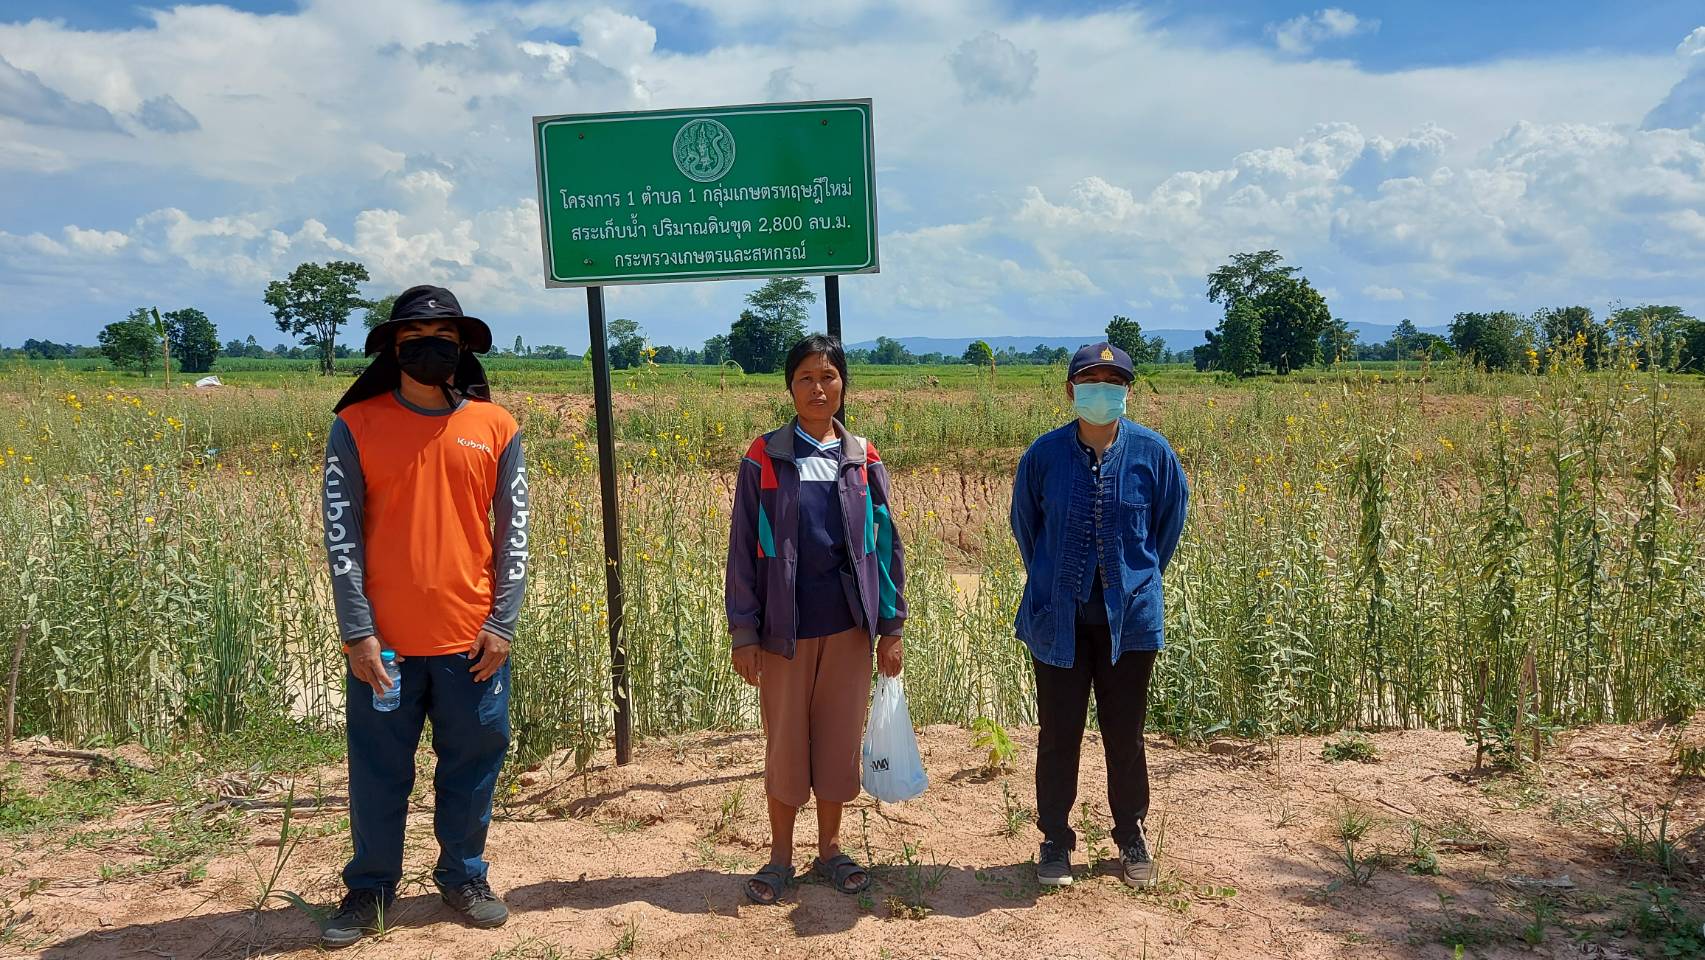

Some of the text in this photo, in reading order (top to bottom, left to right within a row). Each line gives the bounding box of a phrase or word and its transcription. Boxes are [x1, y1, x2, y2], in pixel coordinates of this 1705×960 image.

[560, 176, 852, 209] โครงการ 1 ตำบล 1 กลุ่มเกษตรทฤษฎีใหม่
[571, 212, 851, 241] สระเก็บน้ำ ปริมาณดินขุด 2,800 ลบ.ม.
[614, 239, 807, 268] กระทรวงเกษตรและสหกรณ์
[457, 436, 492, 453] Kubota
[325, 455, 356, 577] Kubota
[508, 466, 530, 580] Kubota
